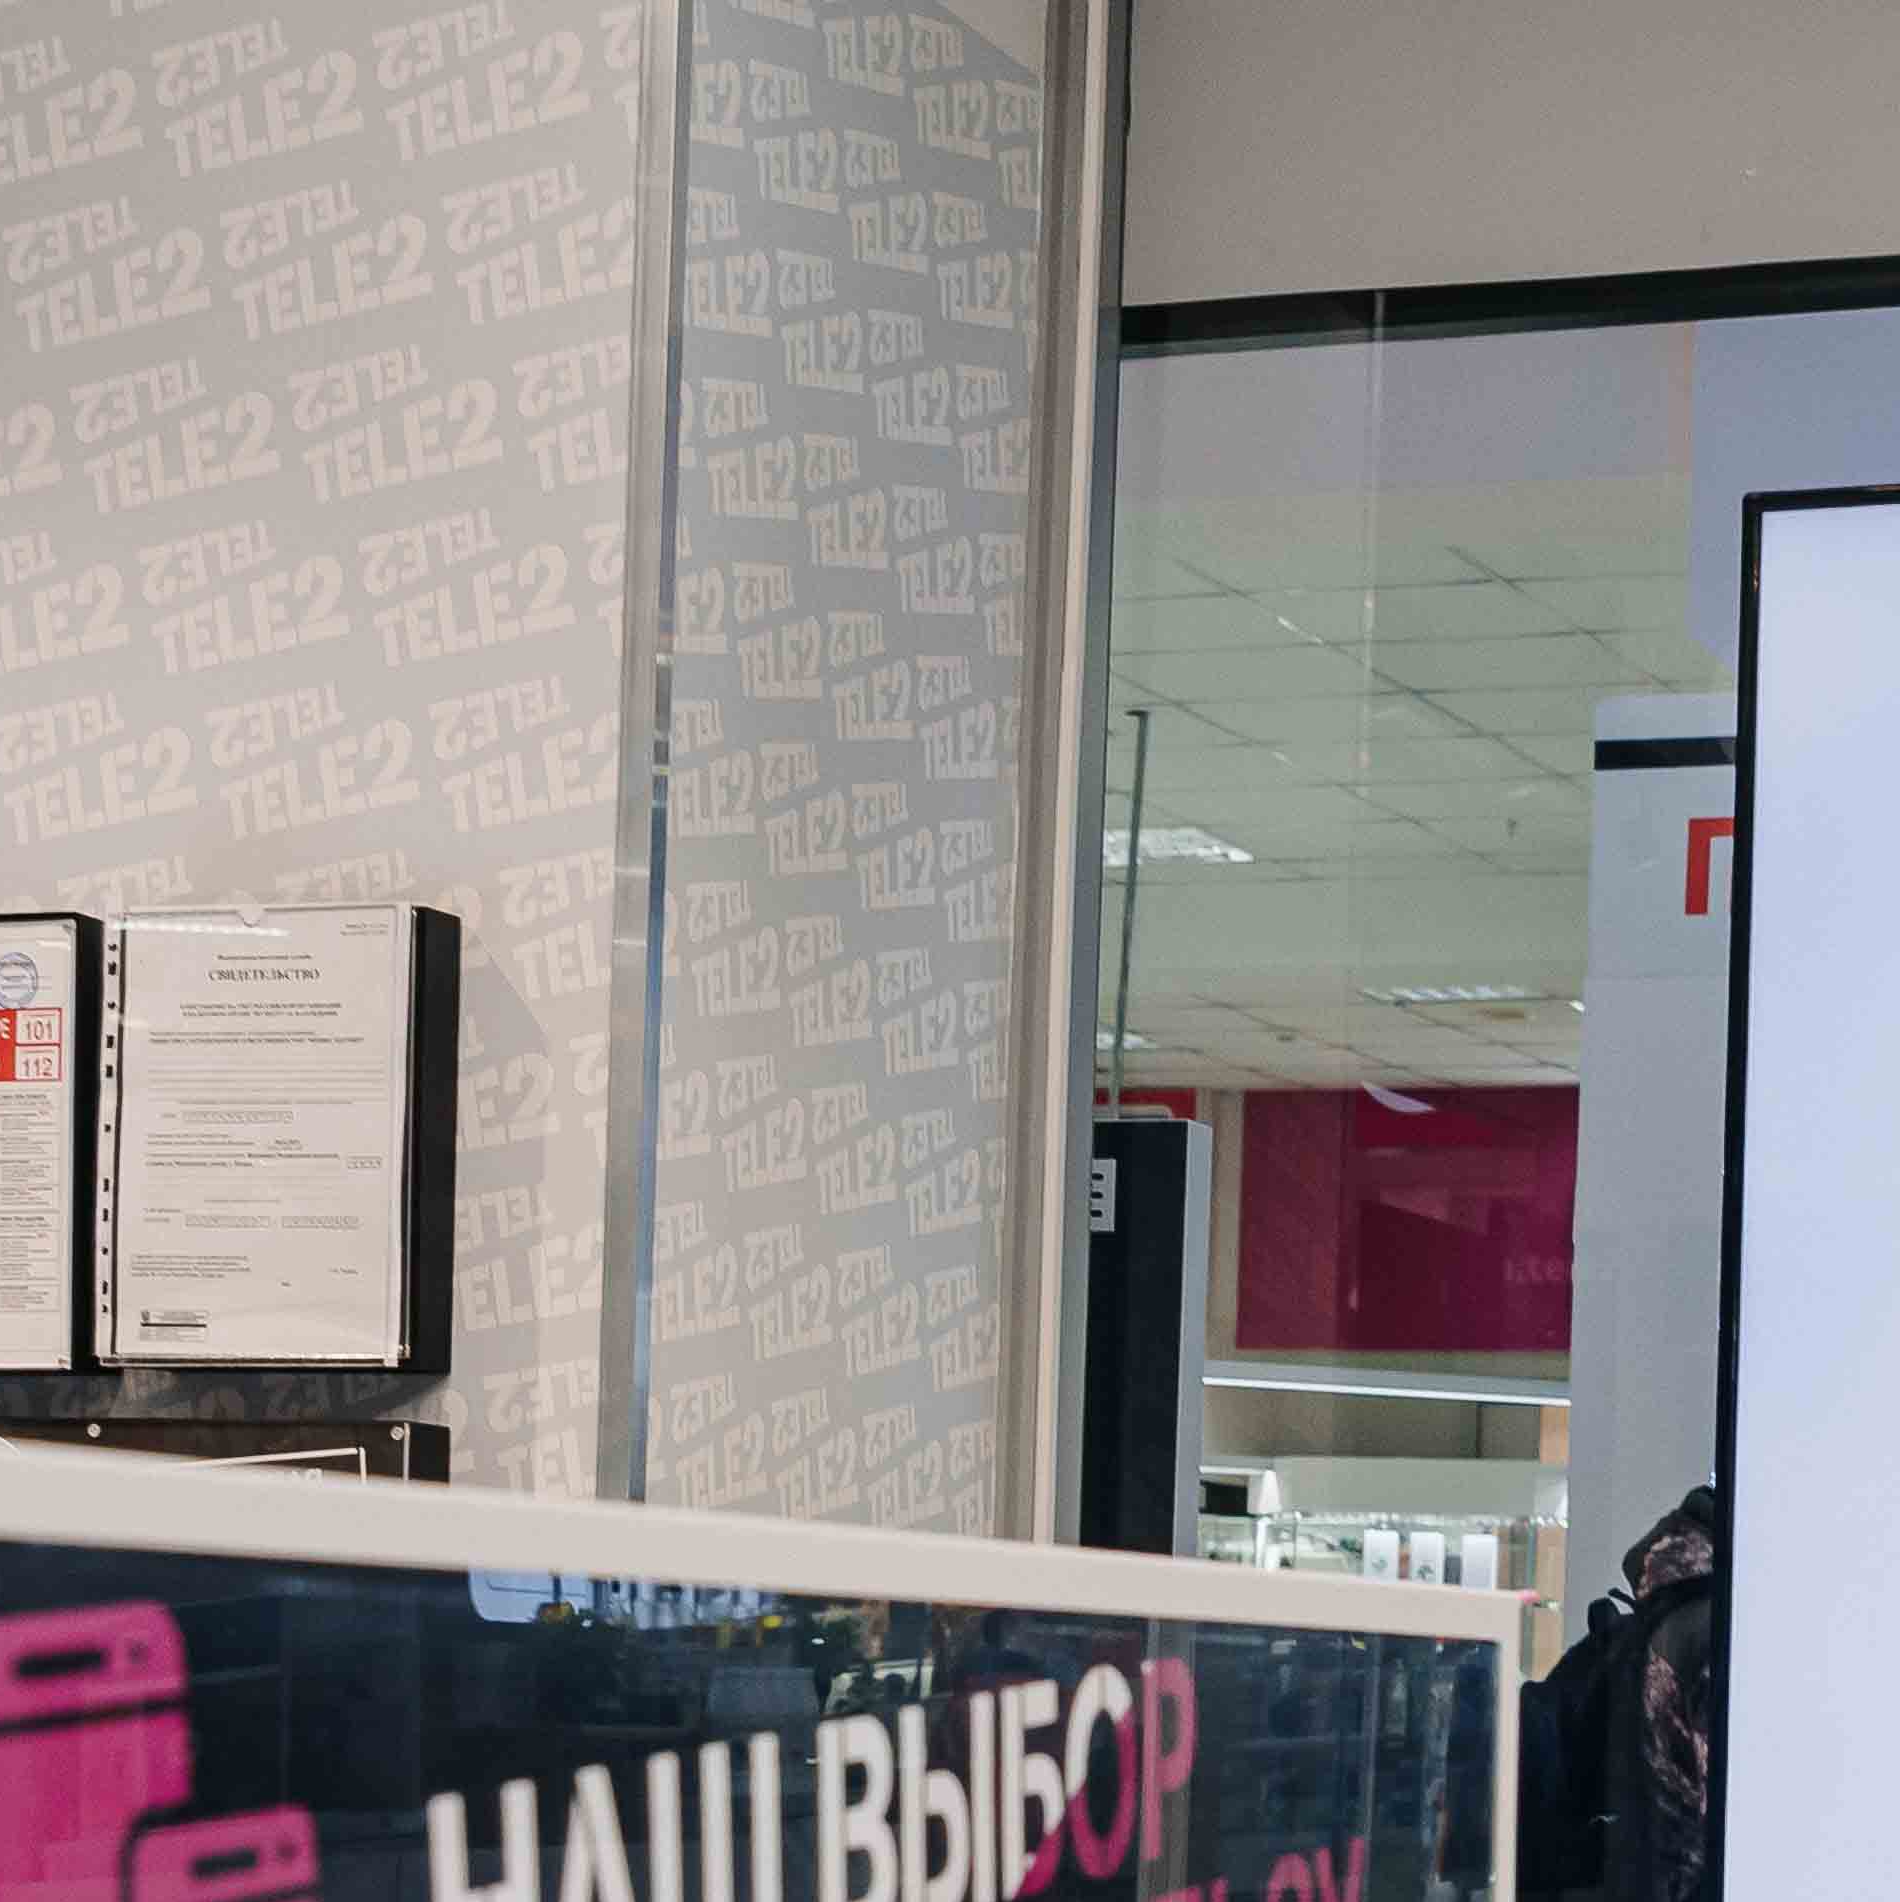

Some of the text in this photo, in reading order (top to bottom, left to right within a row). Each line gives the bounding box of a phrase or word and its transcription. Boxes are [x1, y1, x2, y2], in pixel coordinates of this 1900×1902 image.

[824, 10, 904, 95] TELE2
[164, 49, 362, 178] TELE2
[386, 31, 590, 162] TELE2
[914, 76, 988, 158] TELE2
[754, 127, 838, 213] TELE2
[850, 190, 927, 272] TELE2
[17, 227, 210, 352] TELE2
[233, 212, 433, 340] TELE2
[680, 250, 769, 337] TELE2
[938, 249, 1010, 328] TELE2
[781, 310, 863, 393] TELE2
[303, 377, 504, 503] TELE2
[874, 365, 950, 445] TELE2
[84, 390, 280, 514] TELE2
[709, 435, 795, 520] TELE2
[807, 487, 887, 568] TELE2
[152, 553, 349, 676] TELE2
[373, 543, 576, 668] TELE2
[898, 536, 972, 613] TELE2
[737, 615, 821, 697] TELE2
[833, 660, 910, 738] TELE2
[921, 701, 993, 777] TELE2
[5, 725, 198, 845] TELE2
[221, 718, 420, 840] TELE2
[664, 750, 752, 835] TELE2
[764, 790, 846, 873] TELE2
[858, 828, 934, 908] TELE2
[207, 968, 322, 982] СВИДЕТЕЛЬСТВО
[692, 928, 779, 1015] TELE2
[791, 960, 871, 1045] TELE2
[23, 1056, 53, 1077] 112
[24, 1019, 53, 1040] 101
[882, 991, 956, 1073] TELE2
[721, 1100, 805, 1190] TELE2
[816, 1126, 894, 1213] TELE2
[905, 1150, 977, 1234] TELE2
[748, 1267, 830, 1360] TELE2
[841, 1286, 917, 1376] TELE2
[928, 1304, 998, 1391] TELE2
[676, 1415, 762, 1514] TELE2
[774, 1429, 854, 1525] TELE2
[866, 1442, 940, 1534] TELE2
